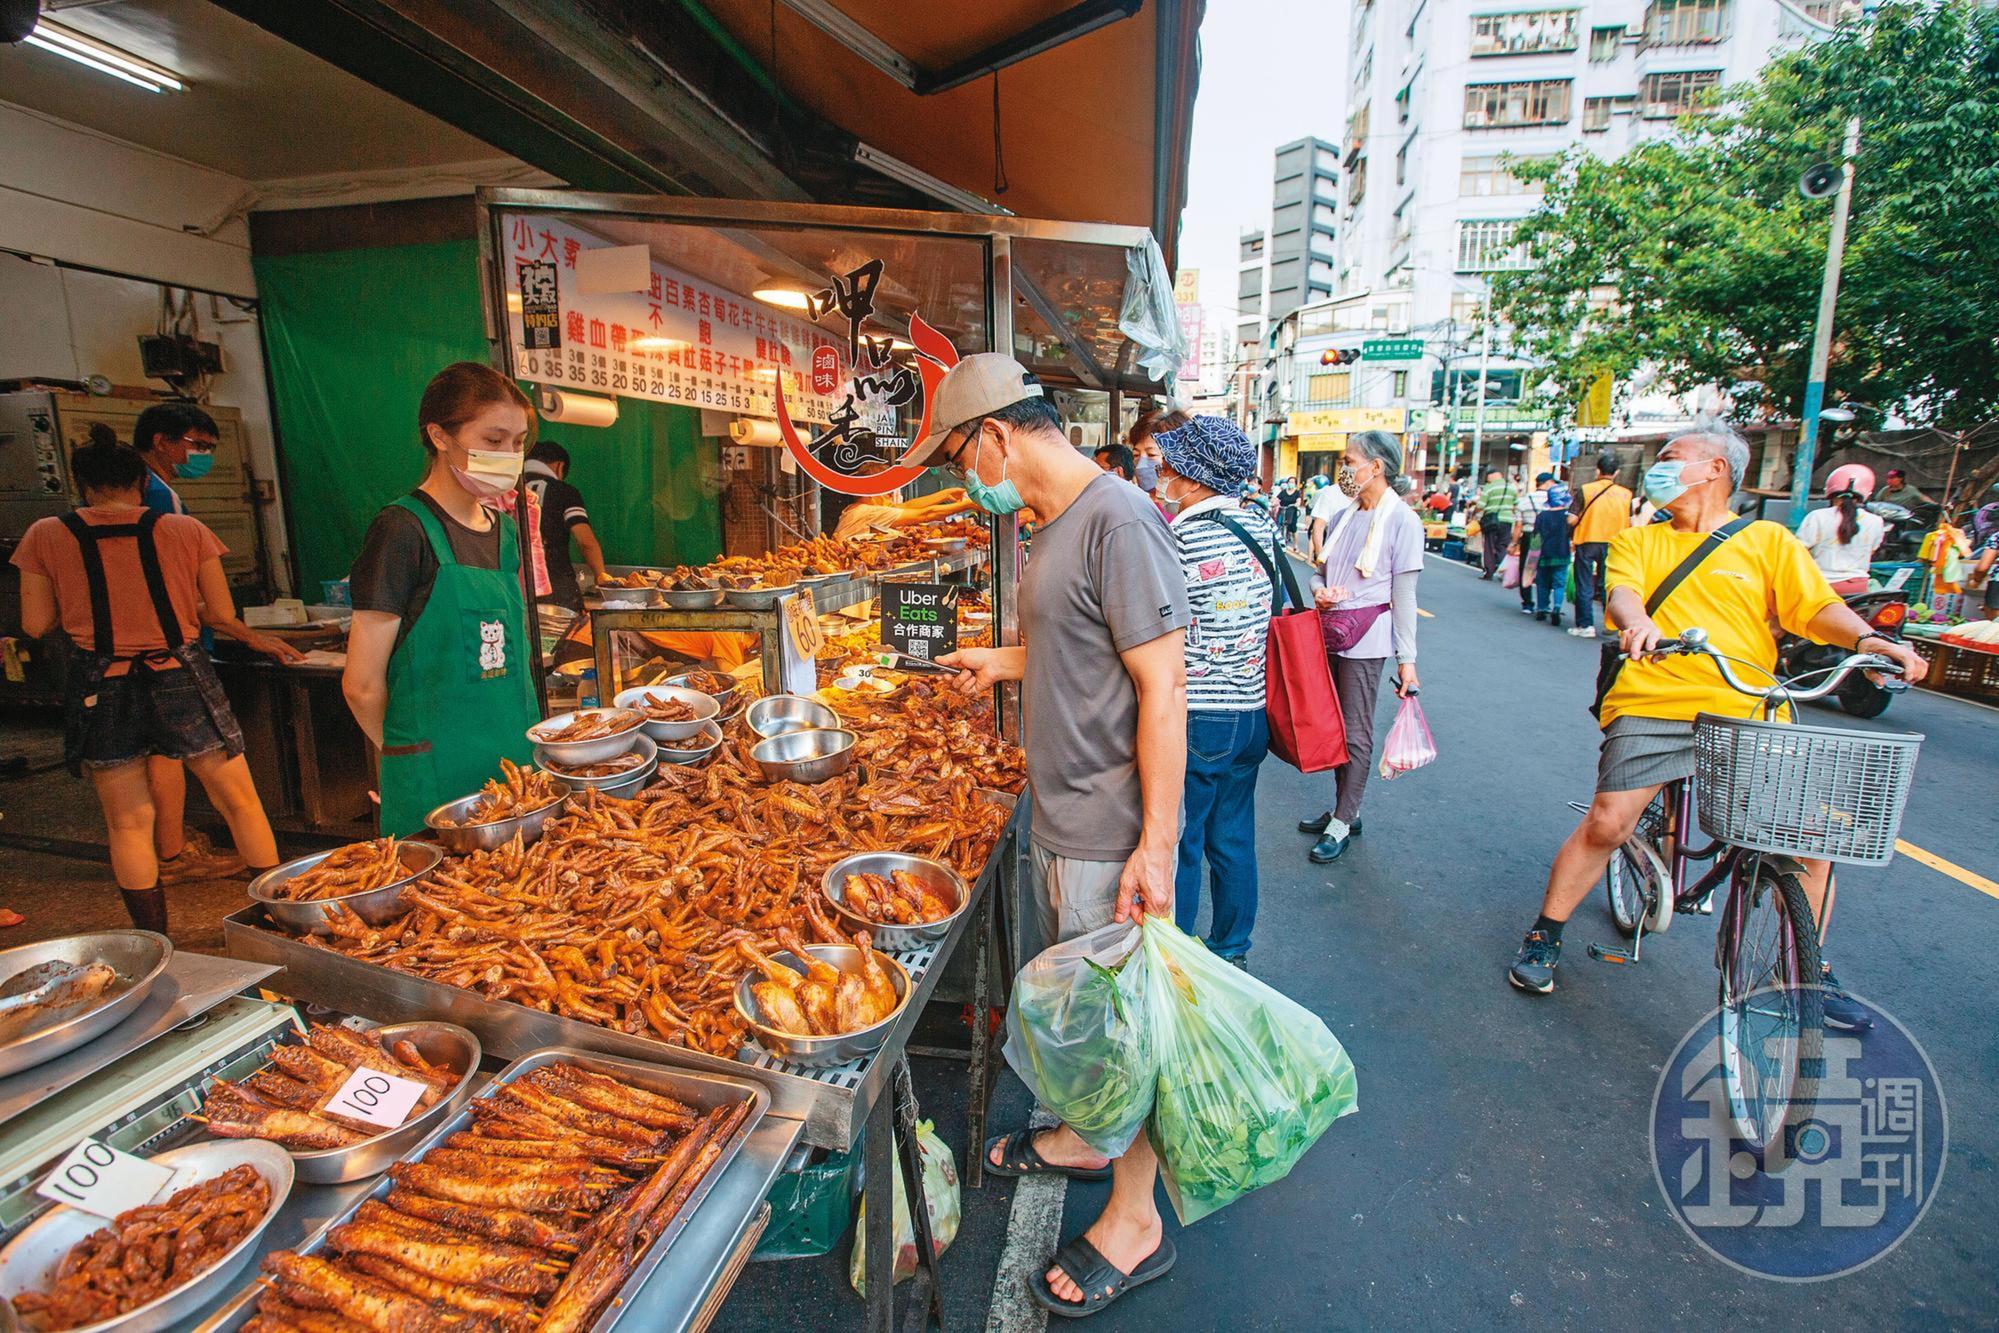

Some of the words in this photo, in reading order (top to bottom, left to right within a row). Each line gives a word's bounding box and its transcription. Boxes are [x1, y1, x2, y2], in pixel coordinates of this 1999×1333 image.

[814, 354, 836, 389] 滷味
[545, 361, 563, 378] 35
[569, 365, 586, 382] 35
[591, 369, 608, 387] 35
[612, 373, 628, 389] 20
[632, 378, 647, 393] 50
[651, 380, 664, 395] 20
[668, 384, 681, 399] 25
[685, 387, 697, 401] 20
[701, 390, 712, 404] 15
[715, 393, 727, 406] 25
[731, 395, 741, 408] 15
[876, 414, 888, 422] JA
[876, 426, 894, 434] PIN
[876, 438, 908, 447] SHAIN
[900, 590, 938, 605] Uber
[900, 605, 938, 621] Eats
[796, 615, 817, 653] 60
[893, 623, 945, 639] 合作商家
[858, 669, 872, 678] 30
[342, 1076, 391, 1116] 100
[53, 1142, 115, 1201] 100
